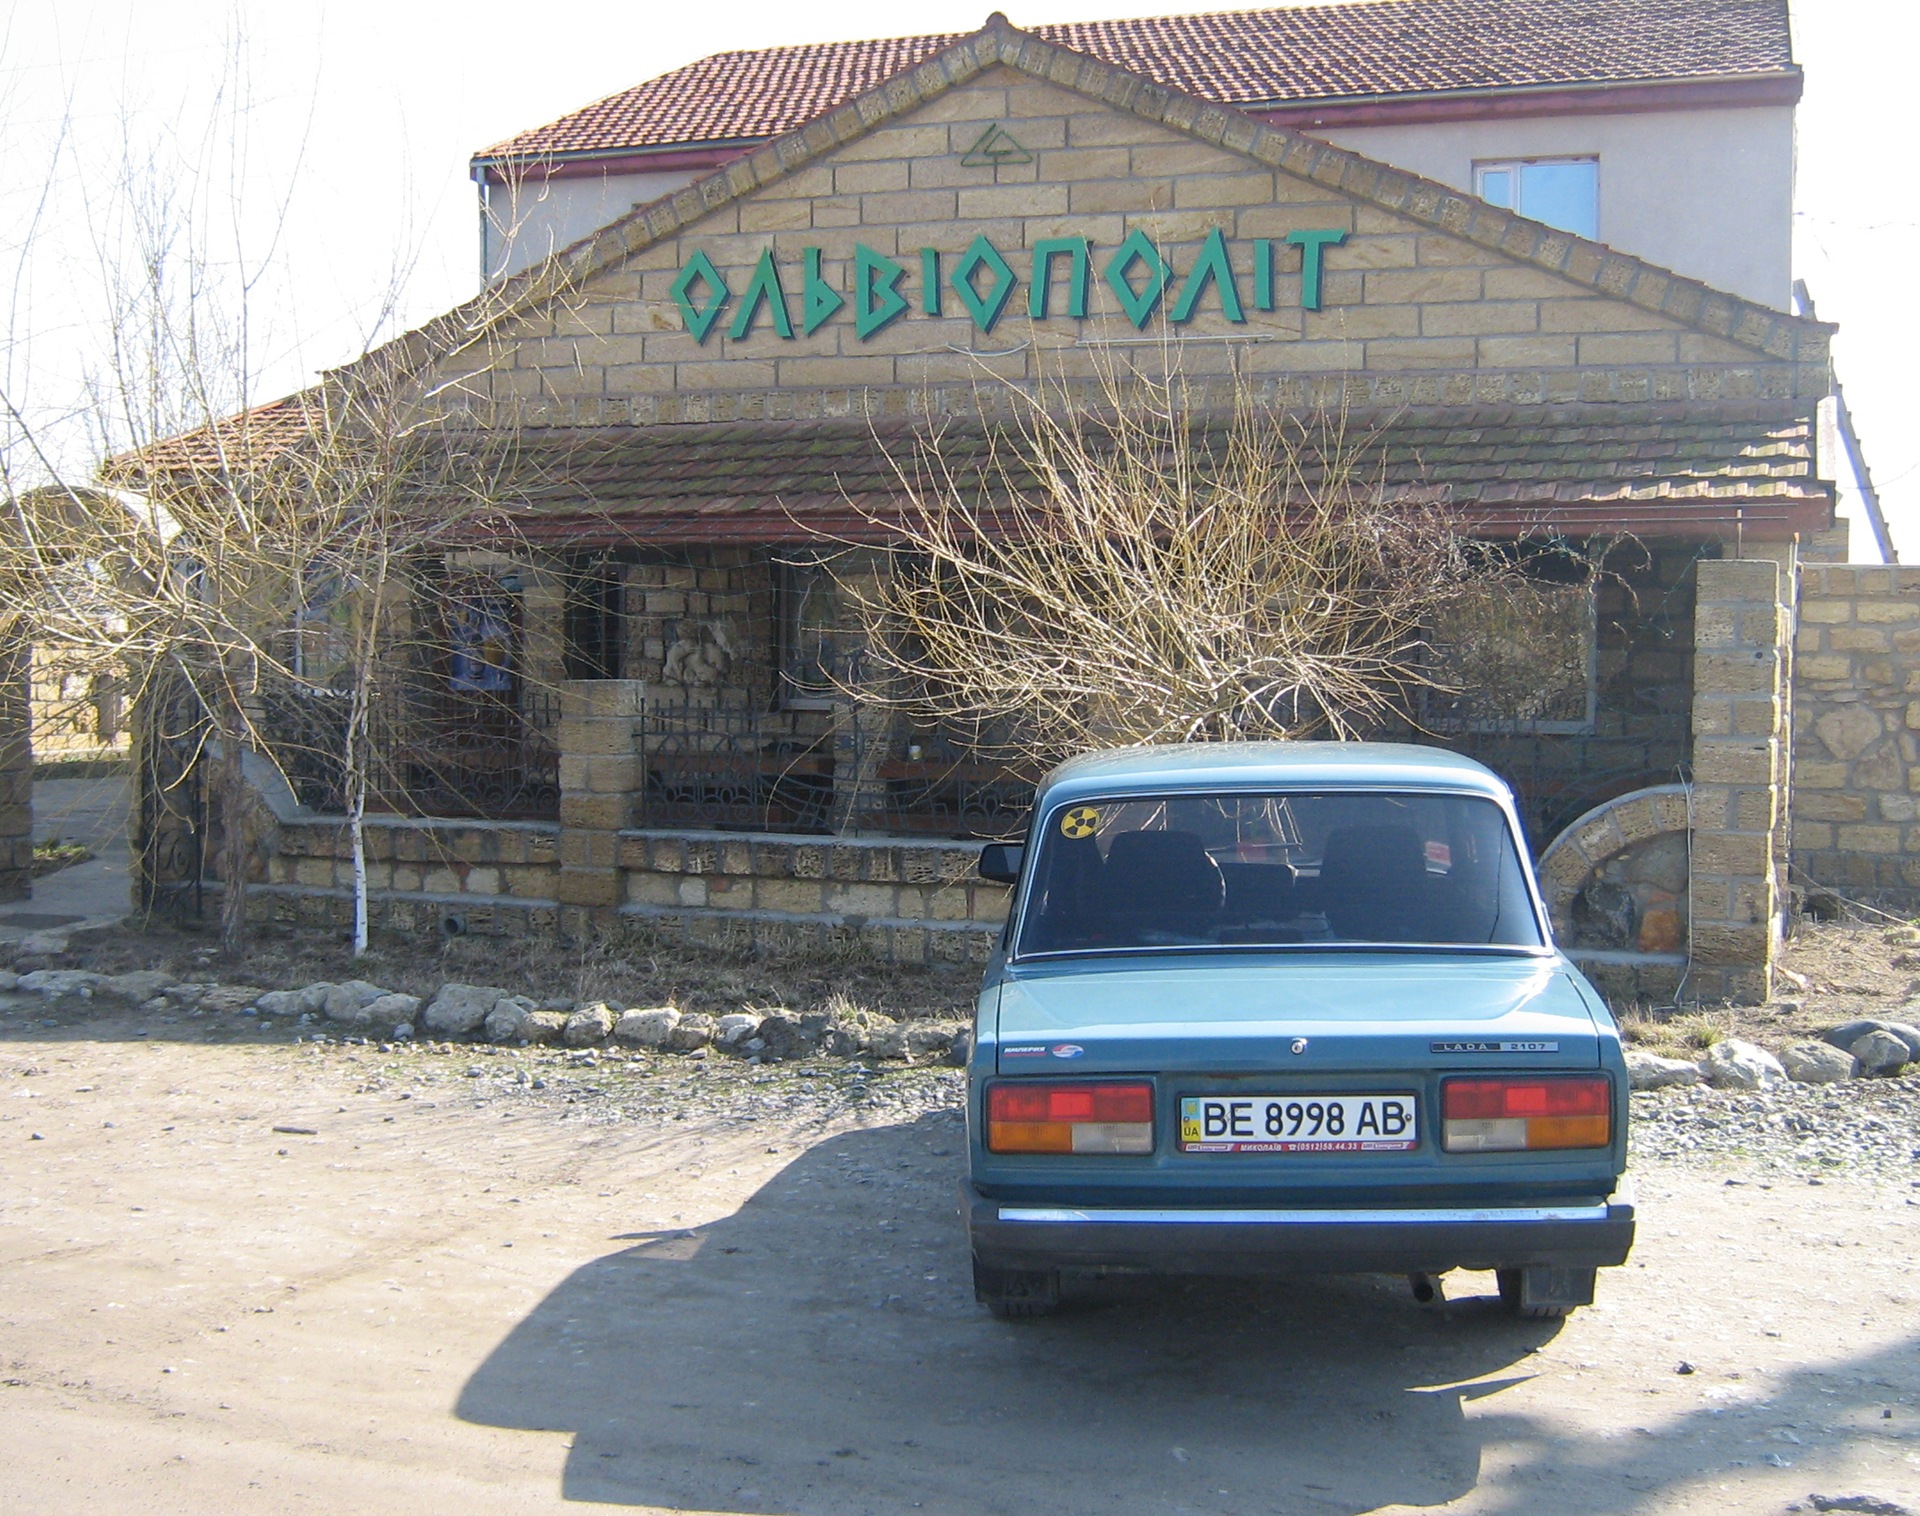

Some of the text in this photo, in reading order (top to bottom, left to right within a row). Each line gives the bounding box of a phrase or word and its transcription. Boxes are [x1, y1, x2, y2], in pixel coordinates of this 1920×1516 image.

[668, 226, 1347, 343] ОЛЬВІОПОЛІТ
[1183, 1126, 1199, 1136] UA
[1203, 1101, 1406, 1136] BE 8998 AB
